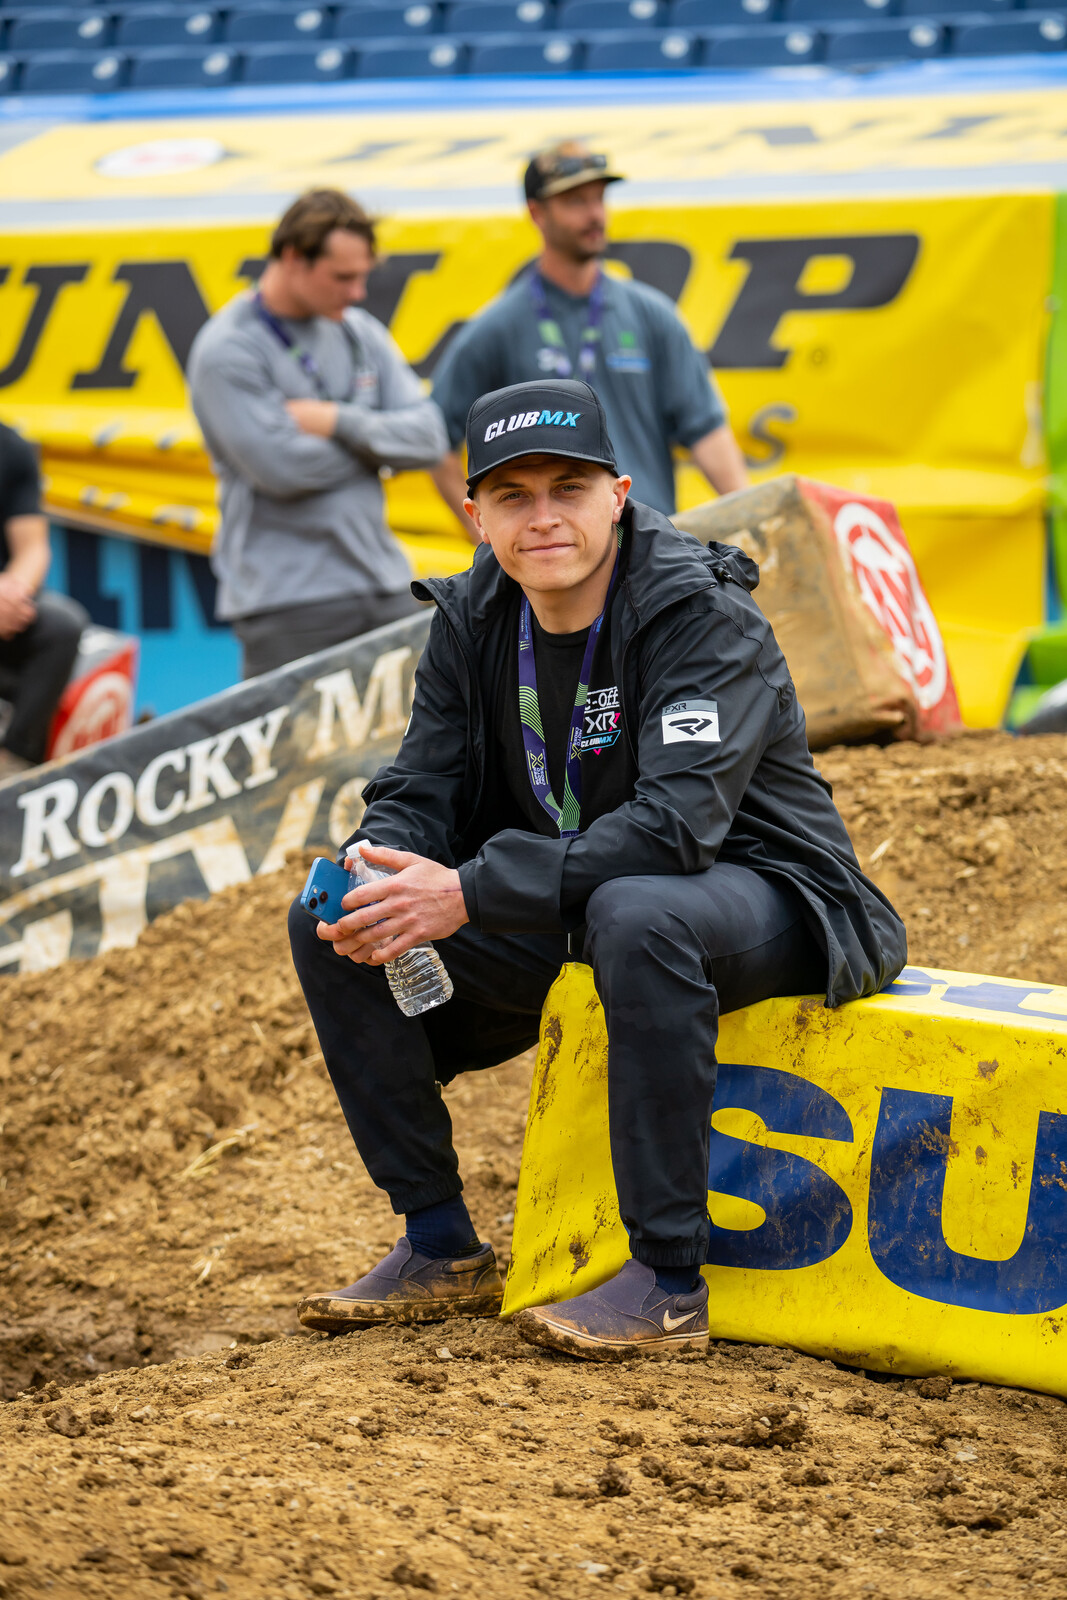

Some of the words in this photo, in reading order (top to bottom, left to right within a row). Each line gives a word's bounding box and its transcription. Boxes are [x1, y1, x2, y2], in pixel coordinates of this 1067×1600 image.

[484, 409, 581, 443] CLUBMX
[664, 702, 687, 713] FXR
[10, 706, 291, 878] ROCKY
